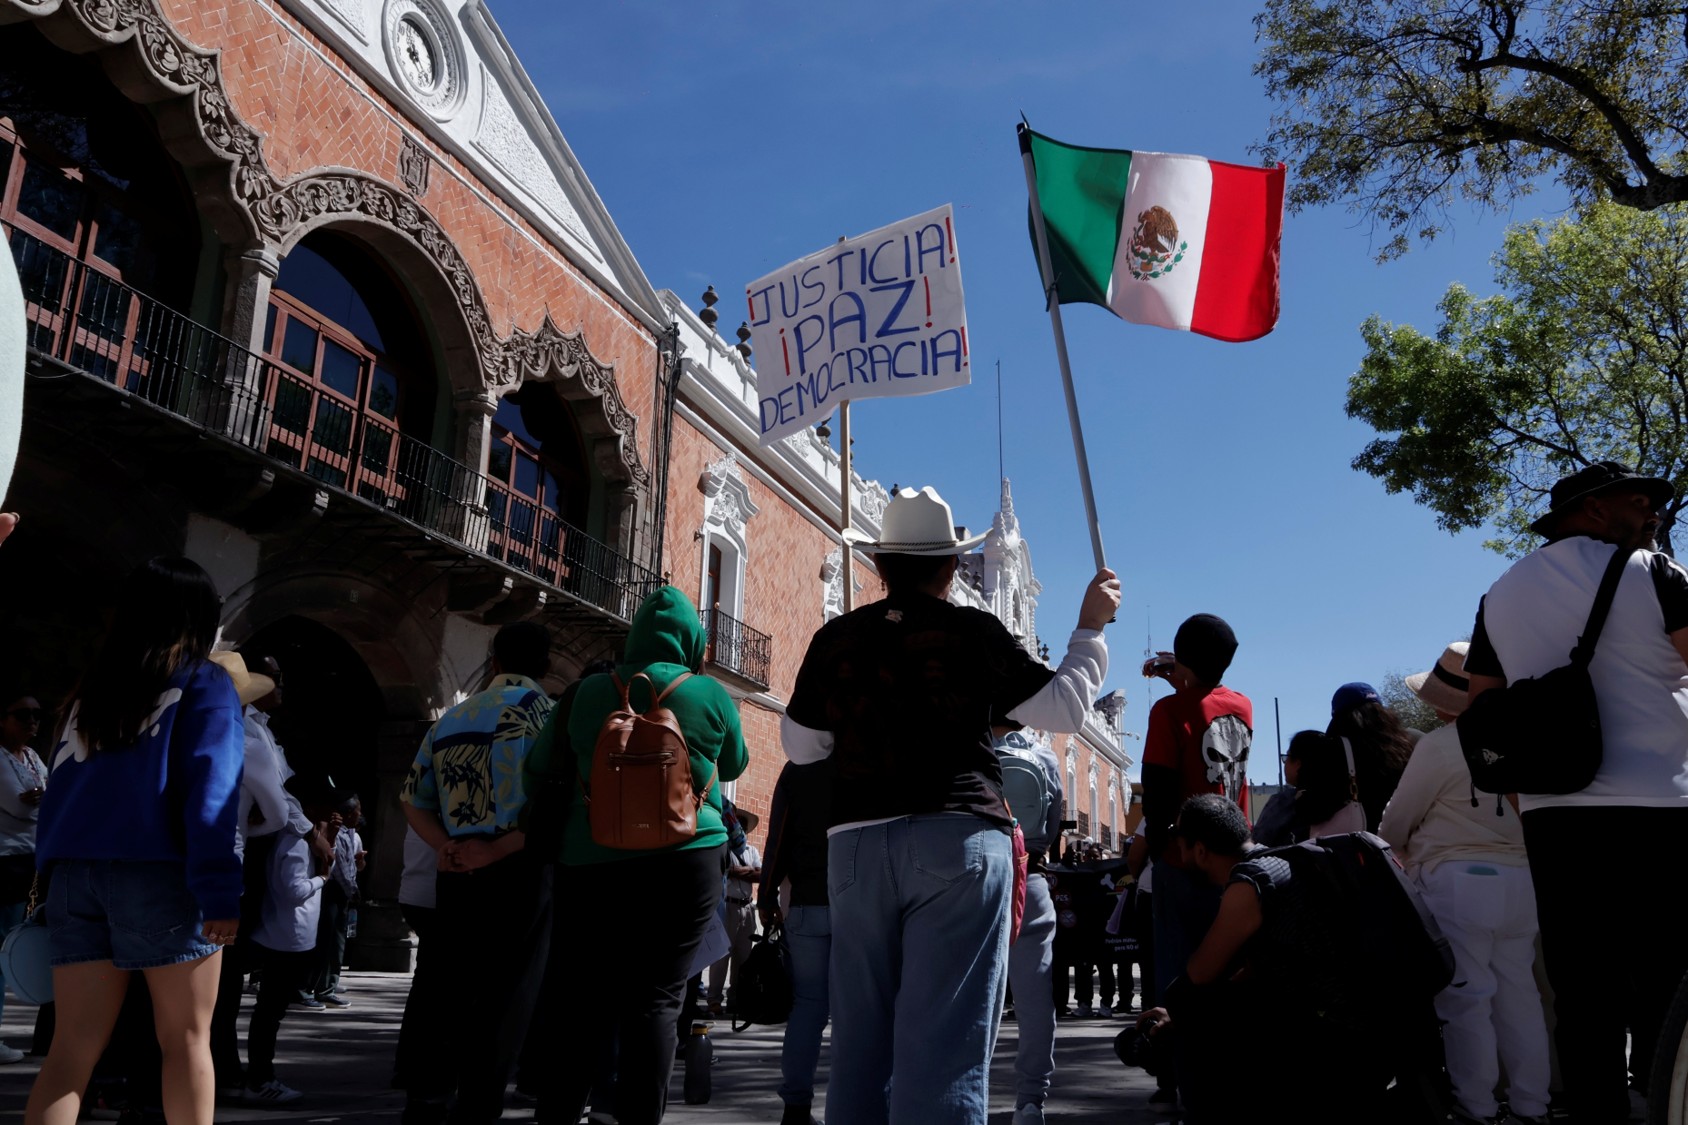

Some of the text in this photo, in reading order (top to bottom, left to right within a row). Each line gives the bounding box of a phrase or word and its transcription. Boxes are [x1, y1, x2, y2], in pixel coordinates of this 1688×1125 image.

[746, 216, 955, 327] ¡JUSTICIA!
[759, 326, 968, 434] DEMOCRACIA!
[779, 276, 933, 377] ¡PAZ!
